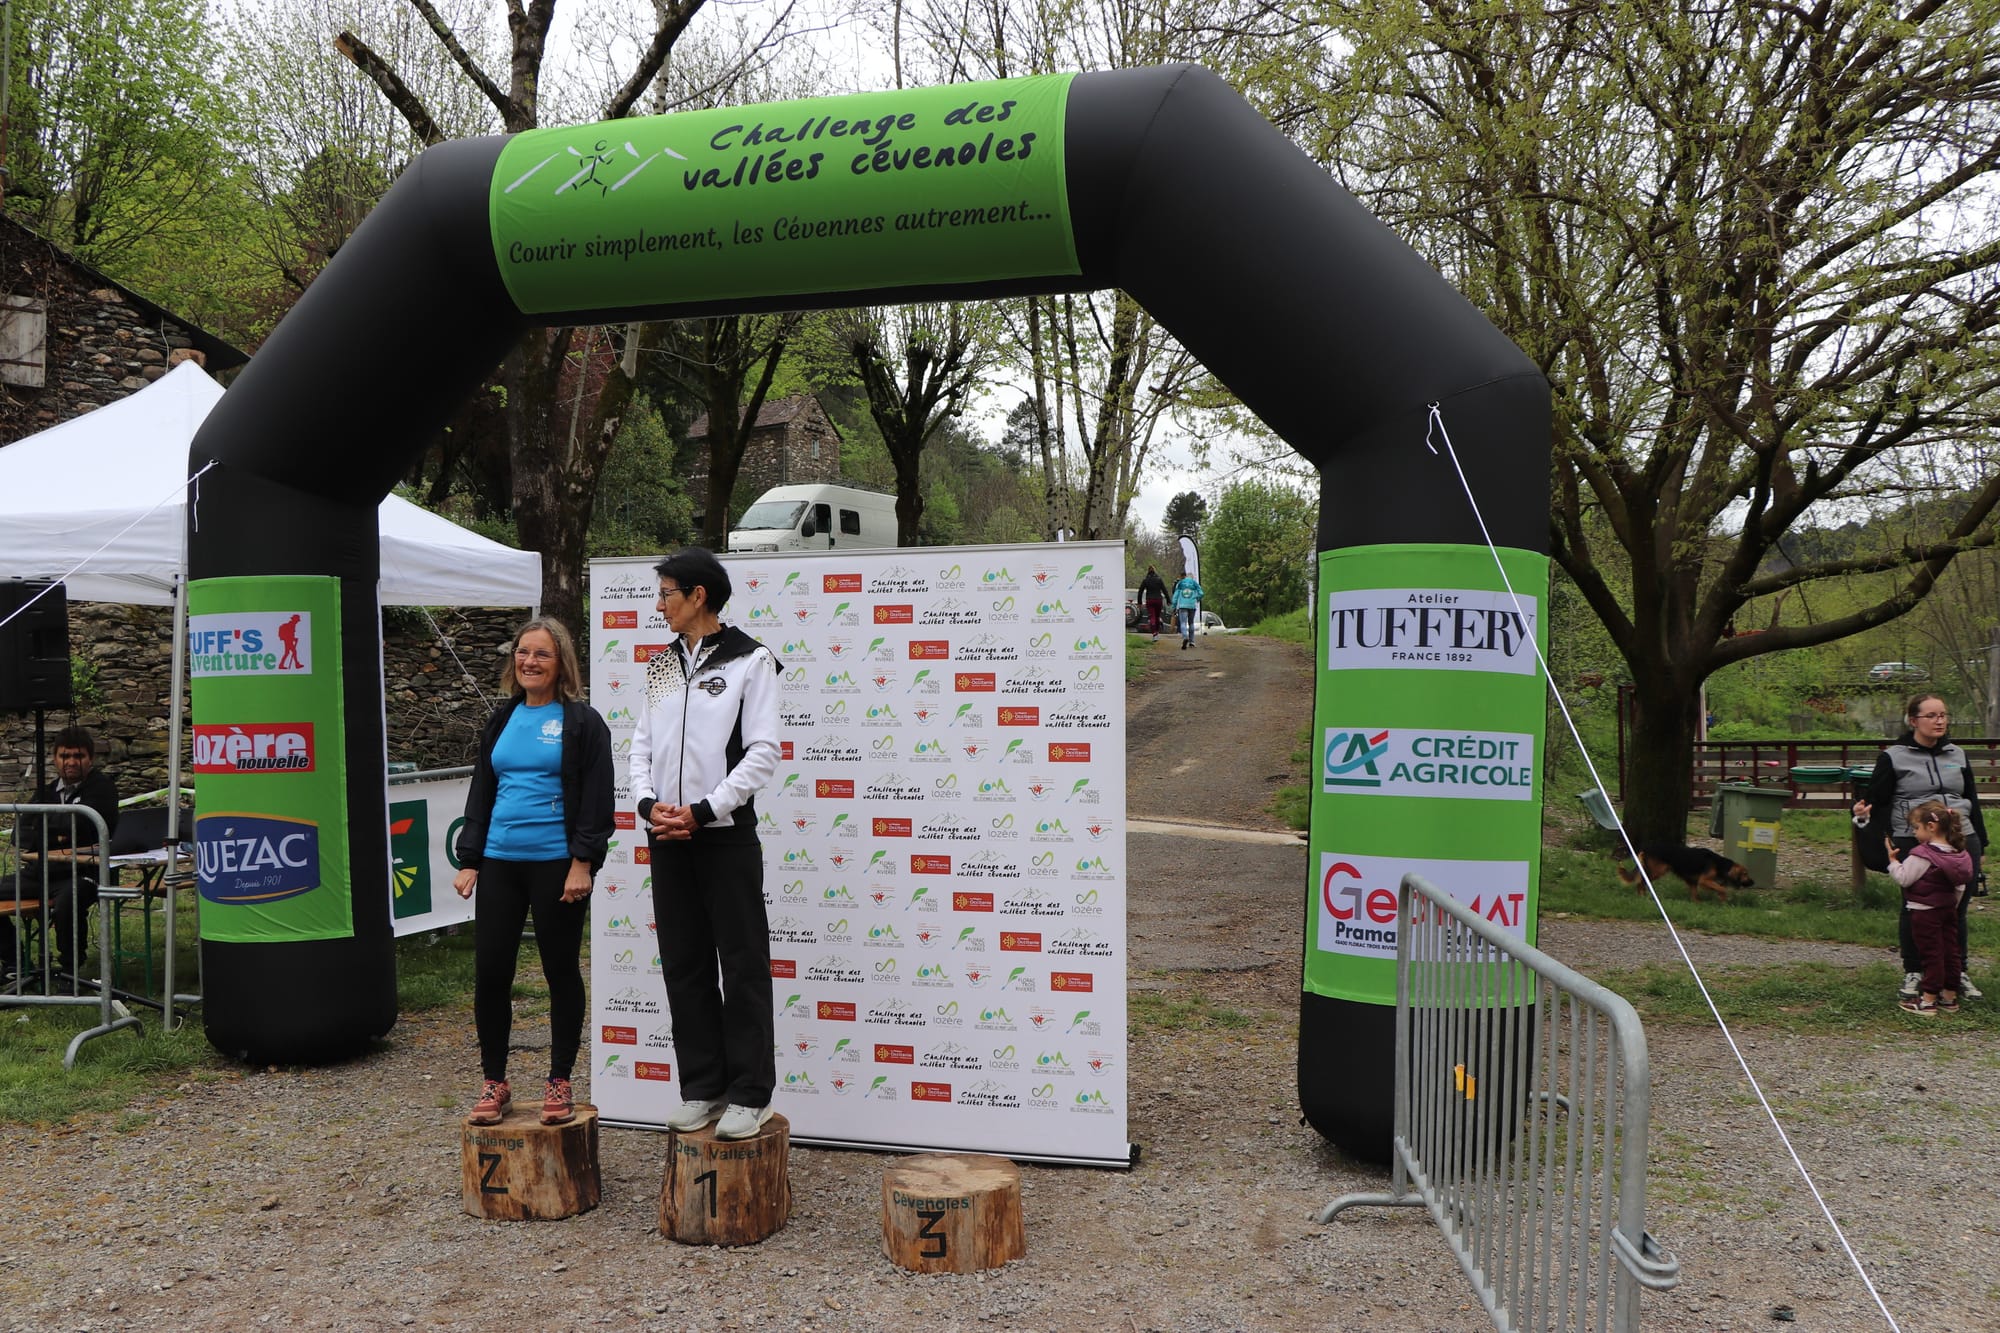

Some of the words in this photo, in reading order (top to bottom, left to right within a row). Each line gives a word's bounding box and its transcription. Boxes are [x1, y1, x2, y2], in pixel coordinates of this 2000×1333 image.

[710, 112, 916, 151] Challenge
[944, 101, 1017, 126] des
[684, 149, 824, 190] vallées
[851, 132, 1036, 176] cévenoles
[509, 238, 577, 264] Courir
[584, 227, 724, 262] simplement,
[733, 220, 764, 245] les
[773, 215, 885, 241] Cévennes
[895, 200, 1052, 231] autrement...
[871, 579, 907, 588] Challenge
[604, 586, 636, 594] Challenge
[897, 585, 928, 593] cévenoles
[1408, 593, 1459, 604] Atelier
[923, 610, 960, 619] Challenge
[1331, 607, 1536, 657] TUFFERY
[959, 646, 996, 655] Challenge
[1392, 652, 1441, 662] FRANCE
[1446, 653, 1473, 662] 1892
[1006, 679, 1044, 687] Challenge
[1049, 713, 1088, 722] Challenge
[805, 747, 841, 755] Challenge
[1412, 735, 1519, 761] CRÉDIT
[236, 755, 310, 770] nouvelle
[1389, 762, 1531, 786] AGRICOLE
[867, 786, 903, 794] Challenge
[922, 825, 959, 834] Challenge
[197, 828, 308, 884] QUÉZAC
[961, 862, 998, 872] Challenge
[987, 870, 1020, 878] cévenoles
[235, 878, 261, 892] Depuis
[263, 875, 282, 887] 1901
[1004, 900, 1042, 909] Challenge
[1030, 908, 1064, 916] cévenoles
[1051, 940, 1090, 950] Challenge
[1079, 948, 1112, 956] cévenoles
[808, 967, 844, 976] Challenge
[833, 975, 864, 983] cévenoles
[608, 998, 640, 1007] Challenge
[868, 1009, 905, 1019] Challenge
[864, 1016, 890, 1024] vallées
[894, 1018, 926, 1026] cévenoles
[923, 1053, 960, 1063] Challenge
[919, 1060, 945, 1068] vallées
[949, 1061, 982, 1070] cévenoles
[961, 1091, 998, 1101] Challenge
[1003, 1093, 1016, 1101] des
[956, 1098, 983, 1106] vallées
[987, 1099, 1020, 1108] cévenoles
[674, 1140, 699, 1157] Des
[694, 1169, 718, 1218] 1
[917, 1210, 947, 1258] 3
